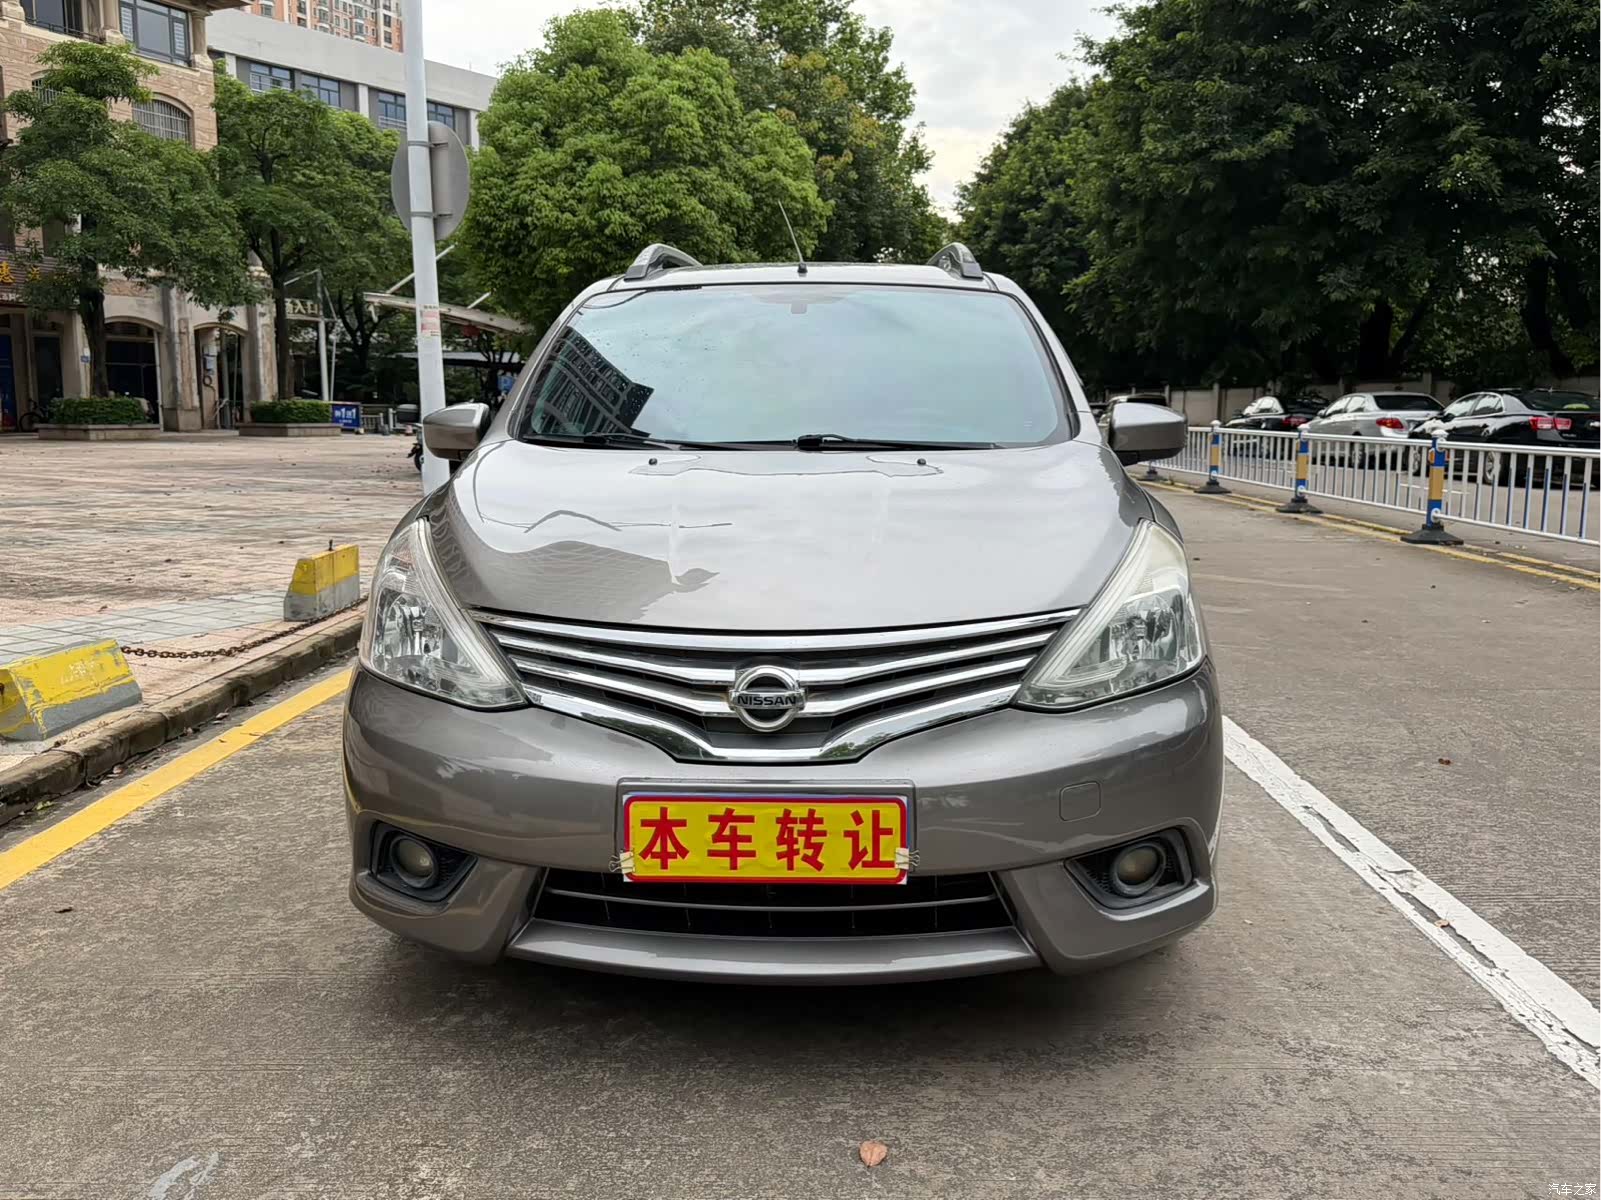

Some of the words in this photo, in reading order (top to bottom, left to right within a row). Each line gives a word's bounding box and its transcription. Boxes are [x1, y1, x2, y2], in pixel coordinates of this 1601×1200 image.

[737, 695, 797, 706] NISSAN
[638, 806, 895, 872] 本车转让
